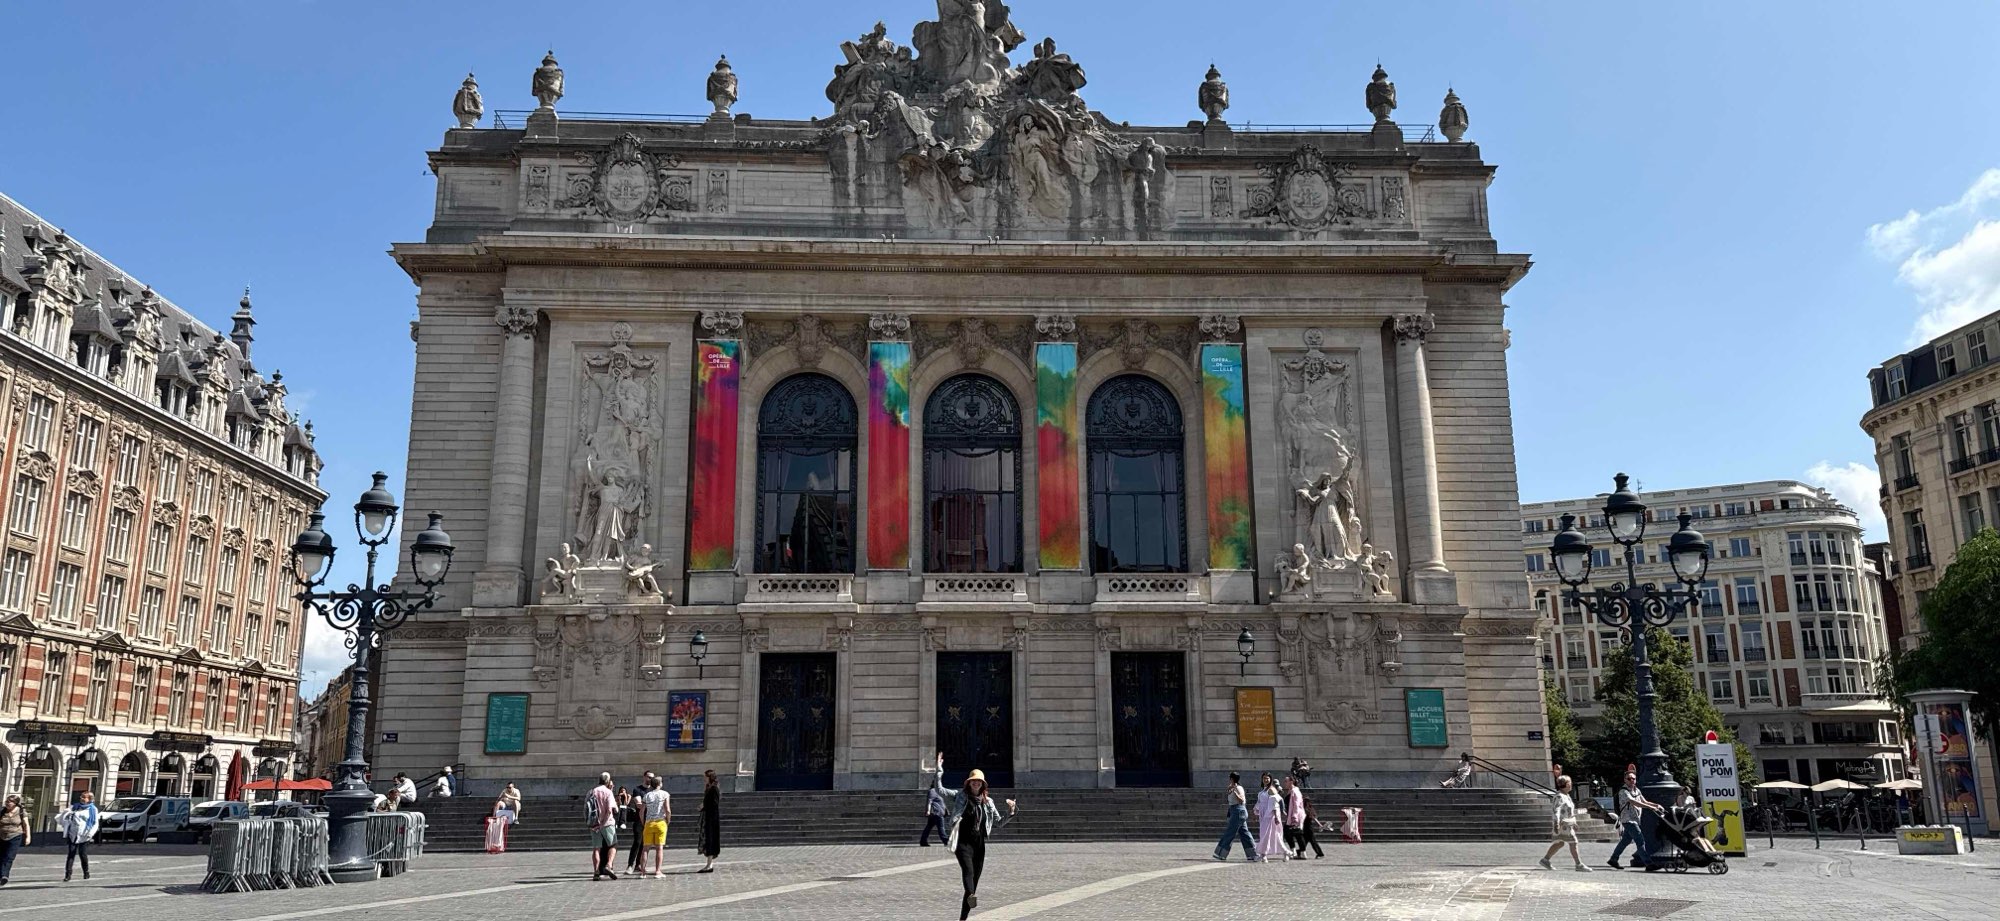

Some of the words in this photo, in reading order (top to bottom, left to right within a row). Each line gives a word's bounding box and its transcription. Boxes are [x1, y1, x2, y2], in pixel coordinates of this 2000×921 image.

[1702, 758, 1724, 767] POM
[1710, 767, 1732, 776] POM
[1706, 788, 1735, 797] PIDOU
